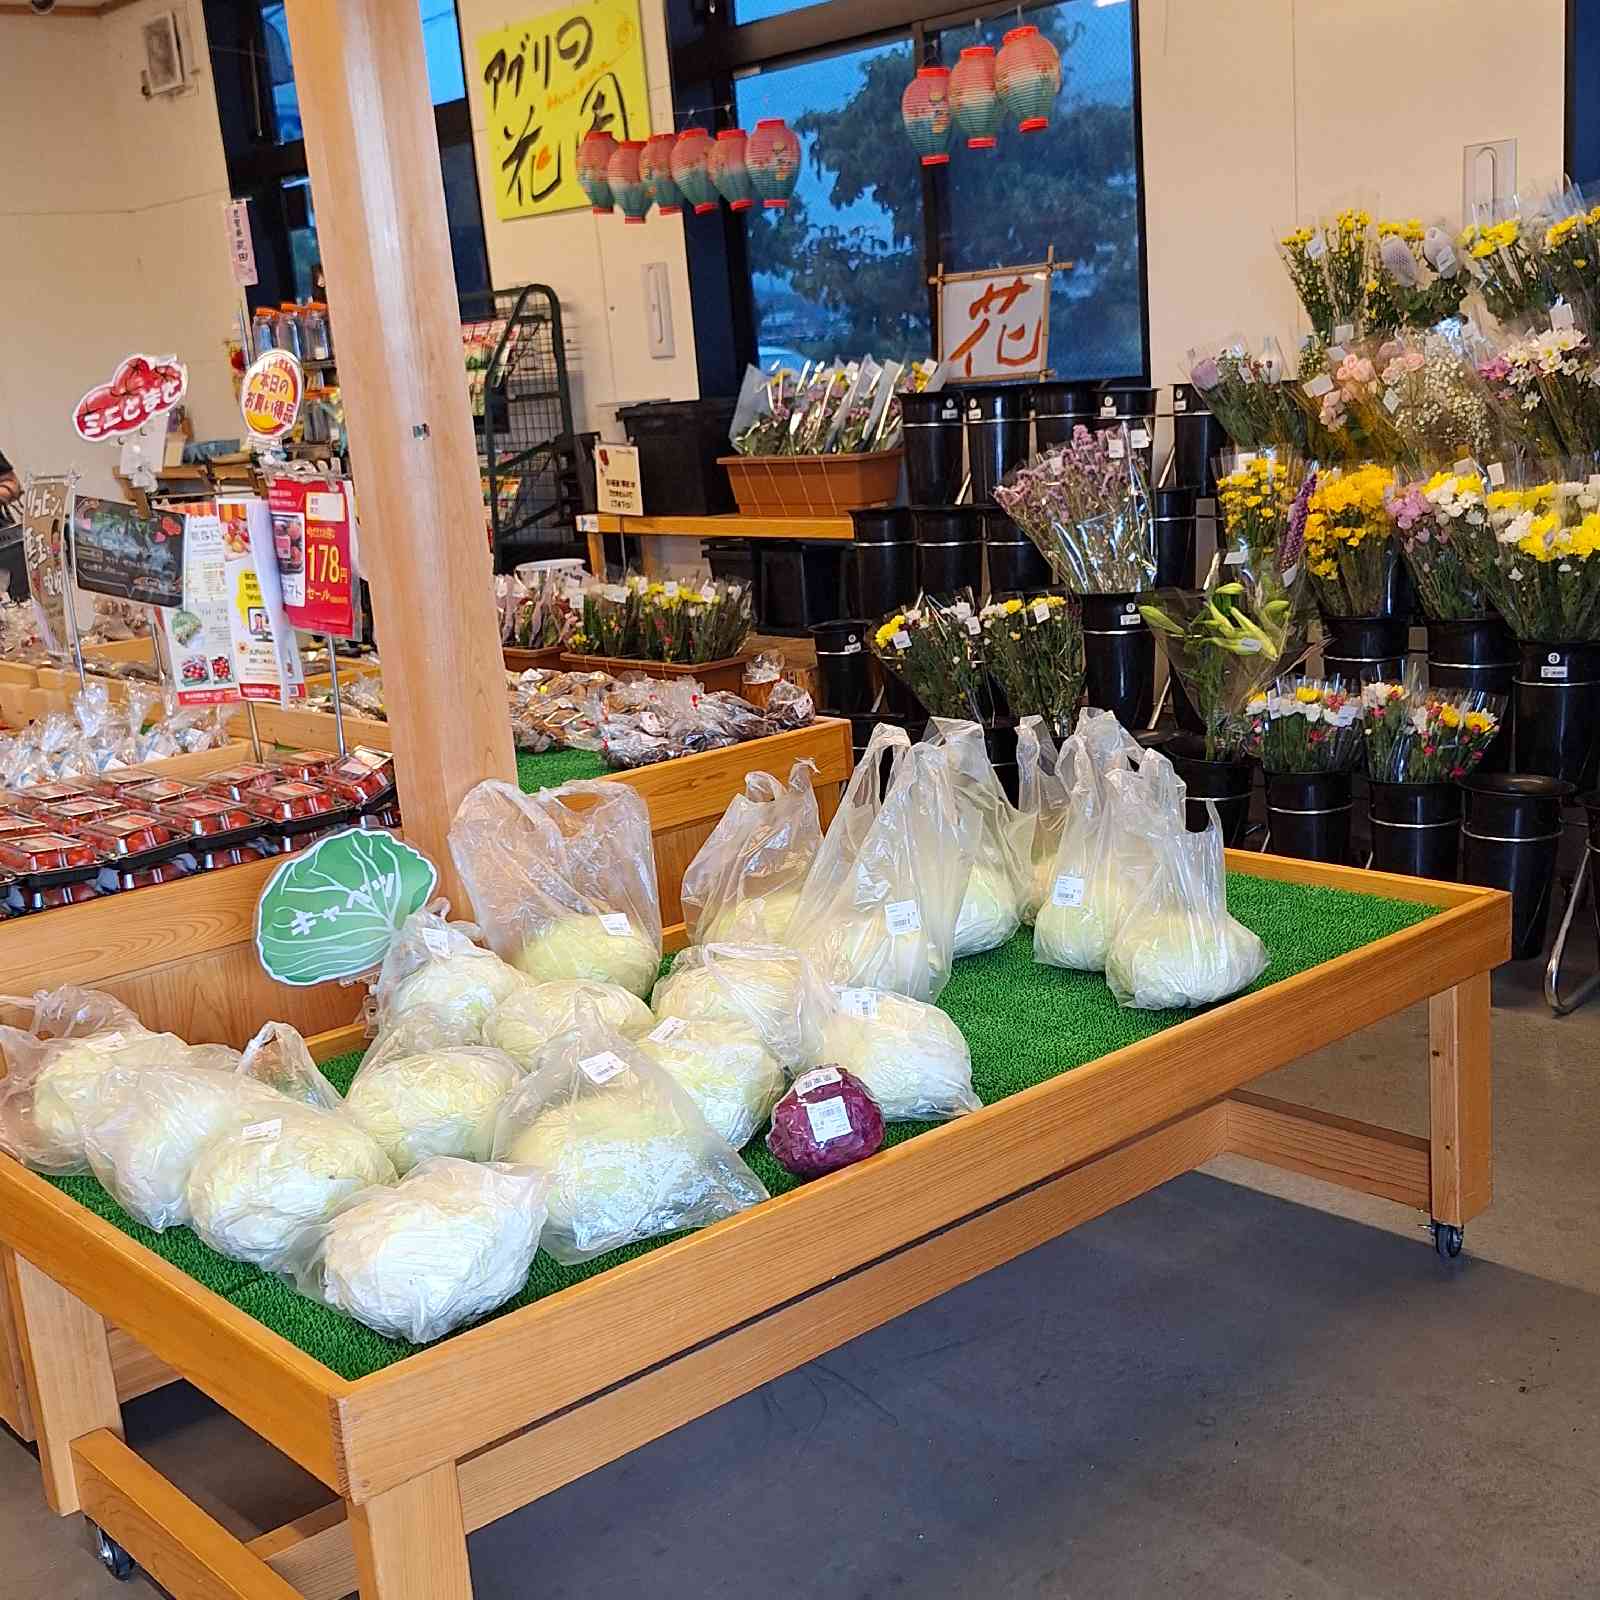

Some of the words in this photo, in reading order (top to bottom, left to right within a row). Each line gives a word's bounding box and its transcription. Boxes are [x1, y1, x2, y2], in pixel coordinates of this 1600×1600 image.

[484, 16, 593, 112] アグリの
[949, 276, 1042, 379] 花
[83, 379, 182, 437] ミニとまと
[245, 391, 297, 424] お買い得品
[260, 372, 289, 395] 本日の
[307, 588, 330, 601] セール
[291, 872, 395, 936] キャベツ
